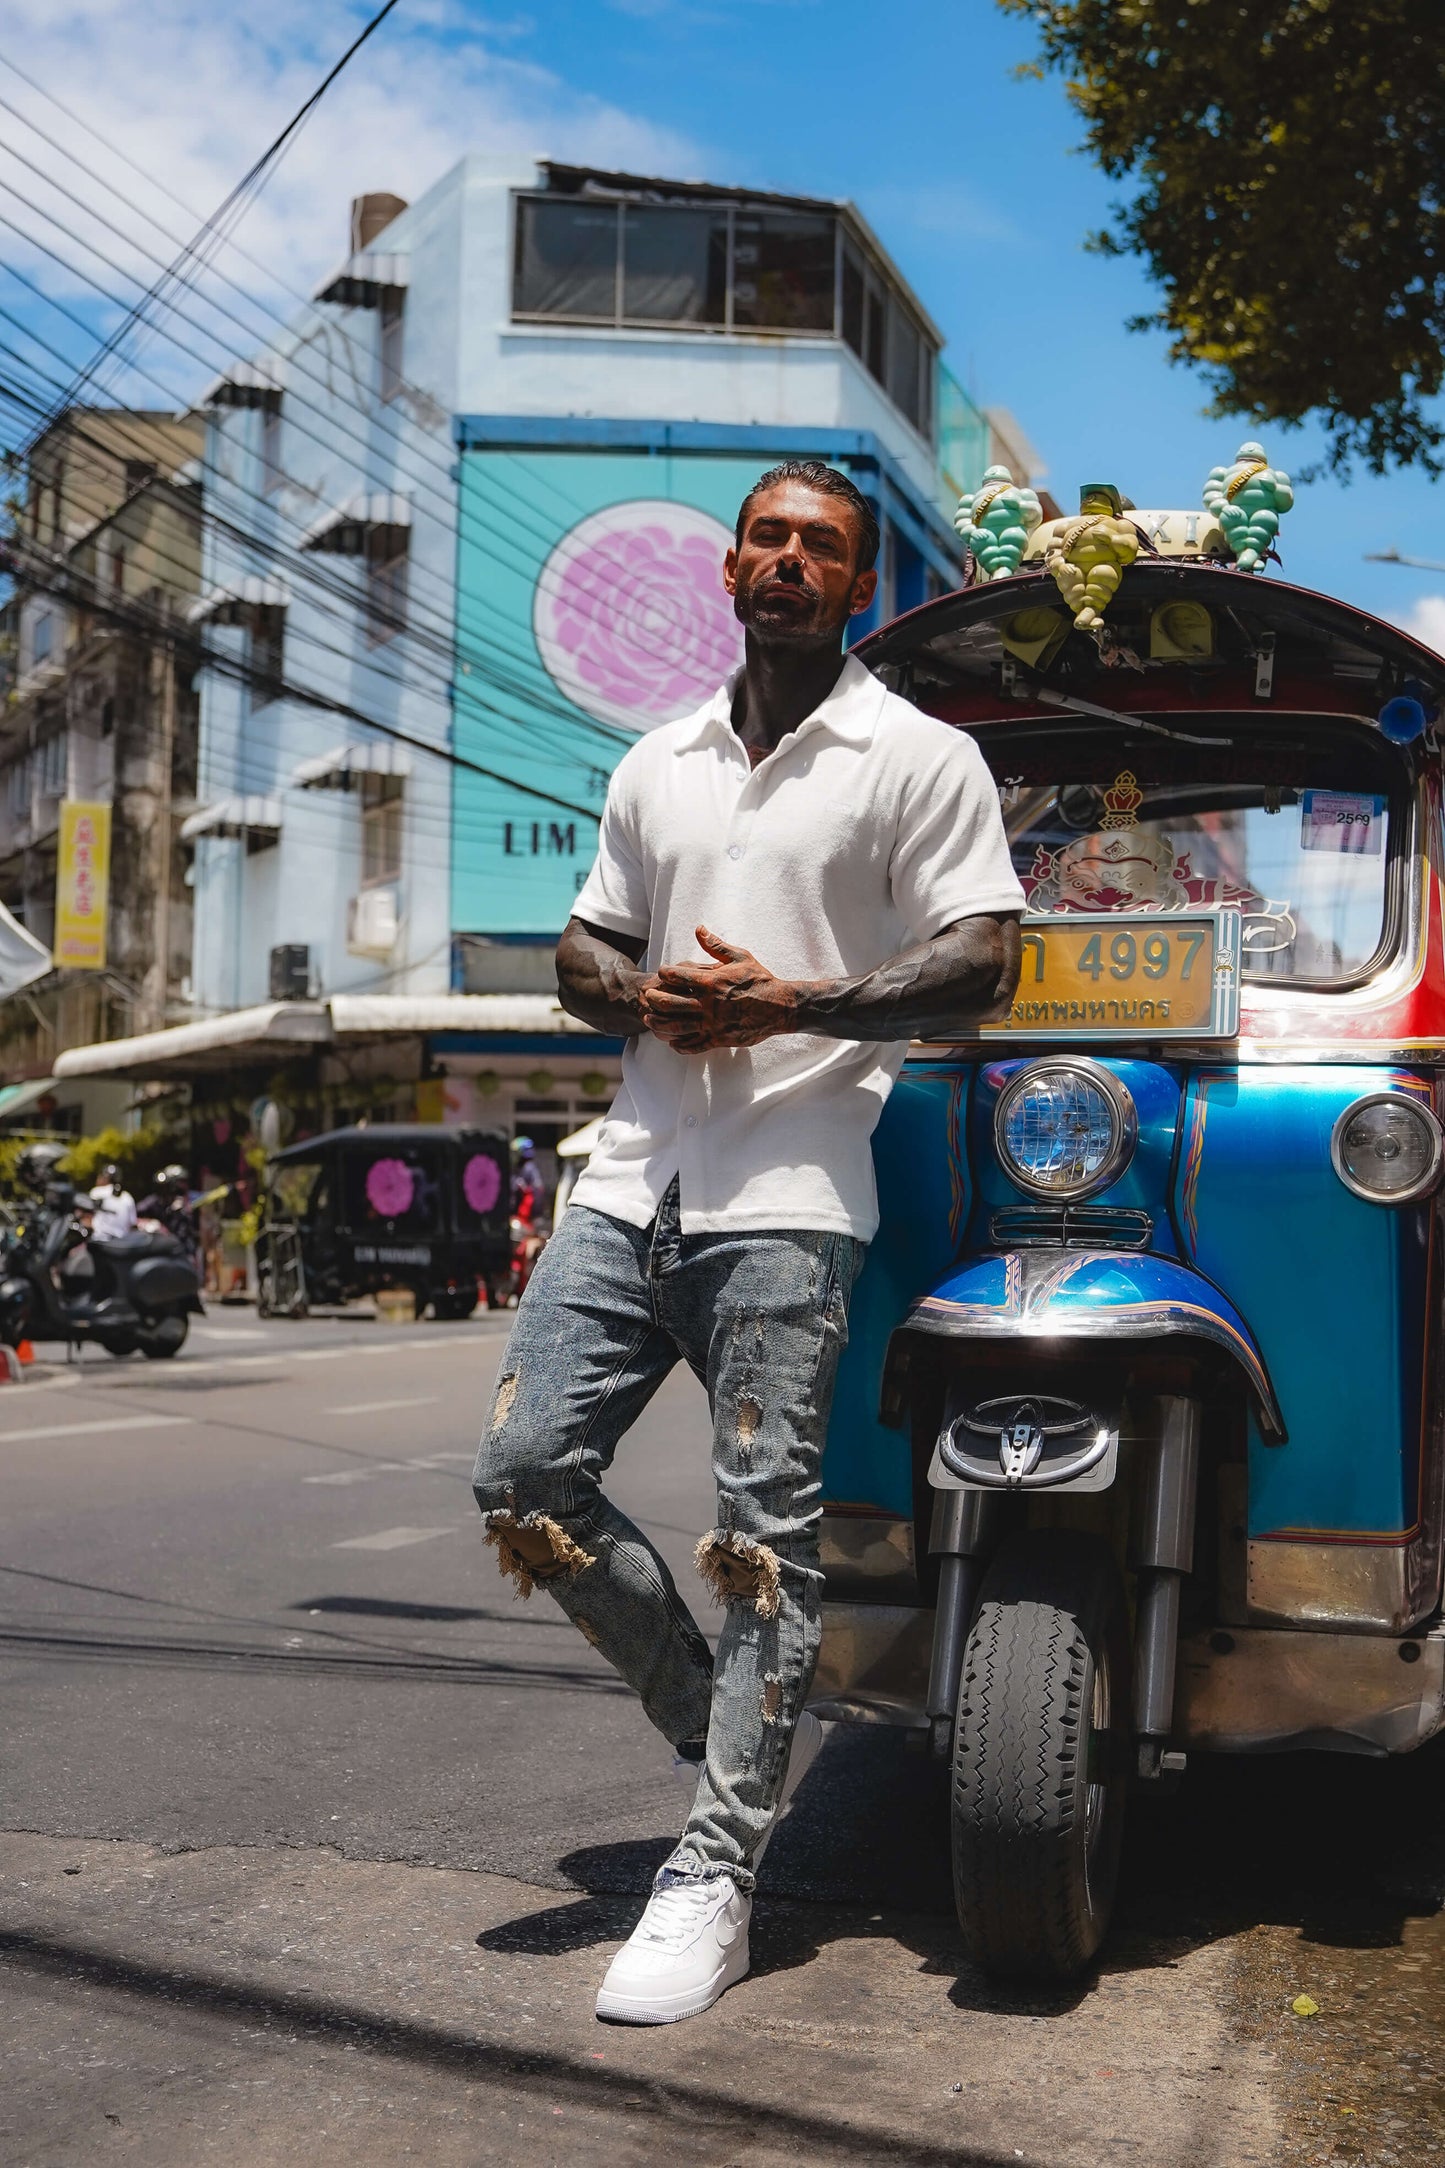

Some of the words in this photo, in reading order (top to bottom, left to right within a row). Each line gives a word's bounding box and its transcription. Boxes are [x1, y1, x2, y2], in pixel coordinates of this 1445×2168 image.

[1147, 514, 1200, 543] XI
[504, 822, 576, 857] LIM
[1077, 930, 1206, 981] 4997
